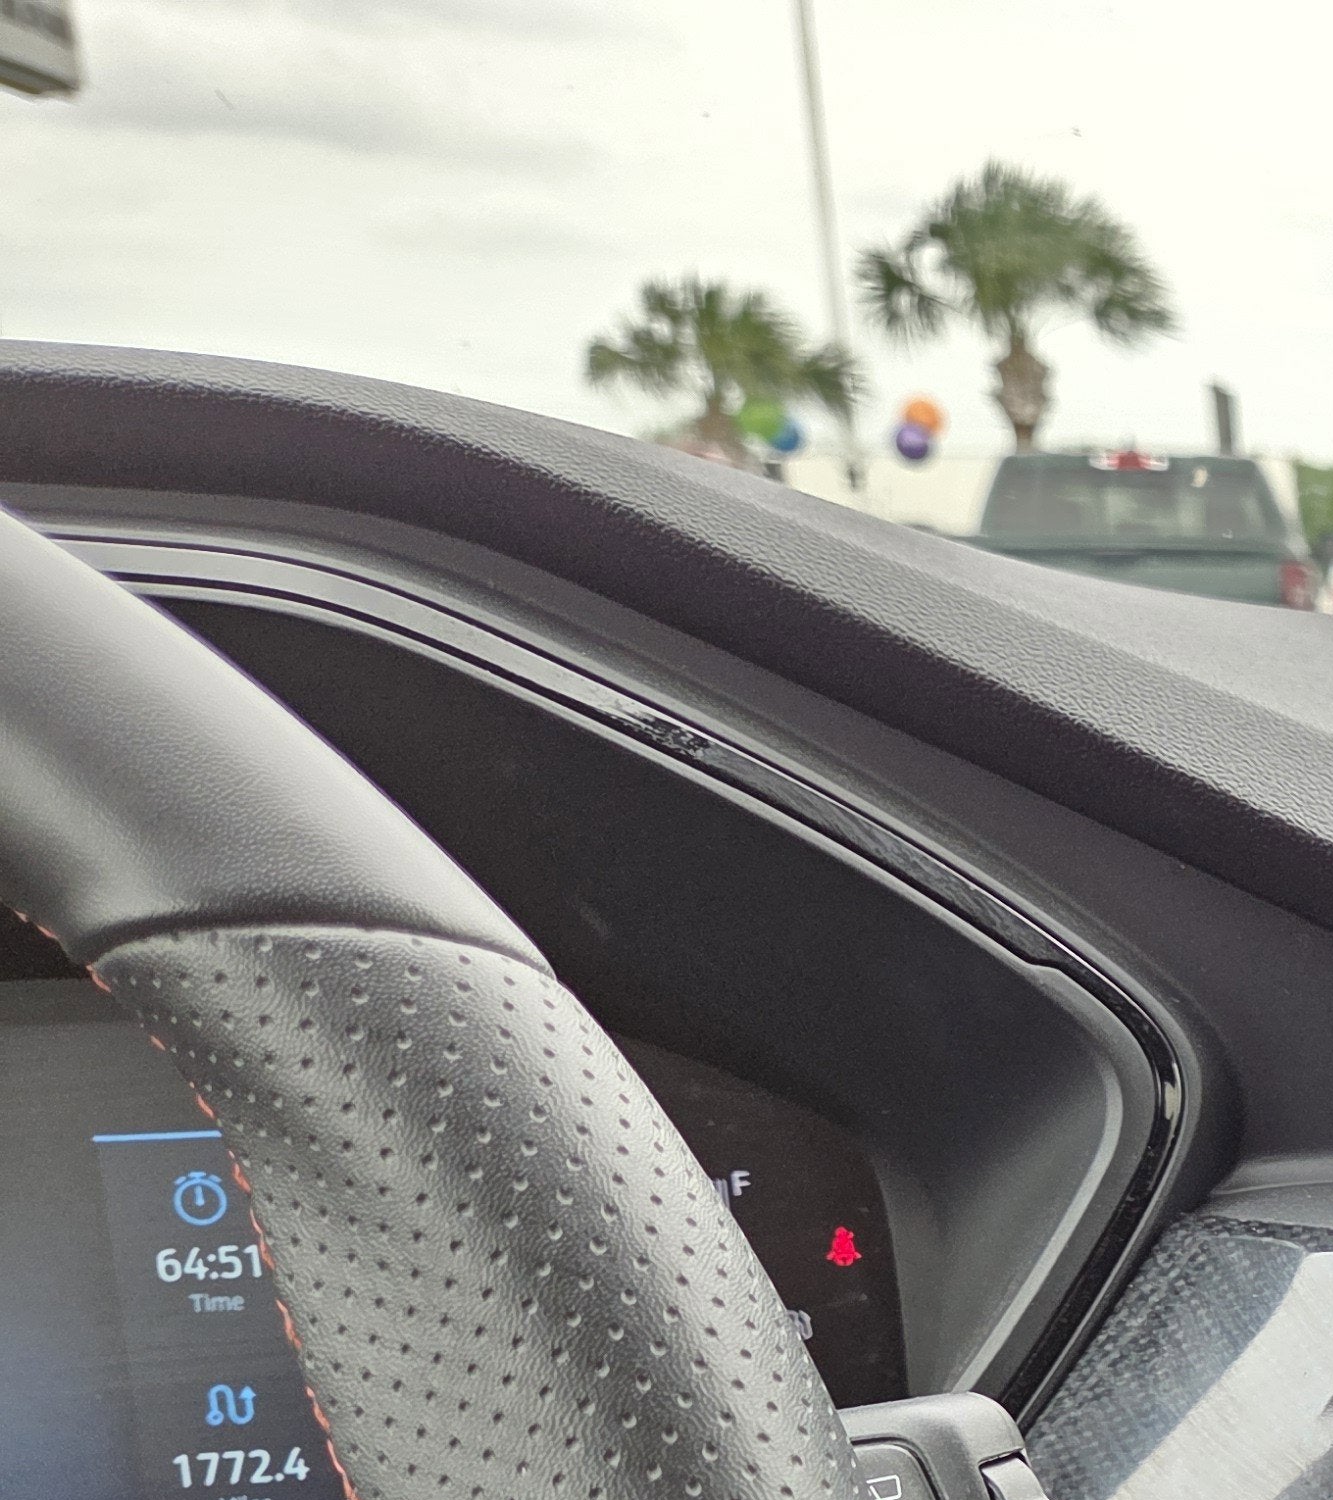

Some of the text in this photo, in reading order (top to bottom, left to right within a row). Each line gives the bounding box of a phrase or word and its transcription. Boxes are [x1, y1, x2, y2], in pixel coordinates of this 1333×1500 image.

[730, 1170, 751, 1196] F
[155, 1244, 263, 1285] 64:51
[189, 1291, 245, 1314] Time
[173, 1446, 310, 1489] 1772.4
